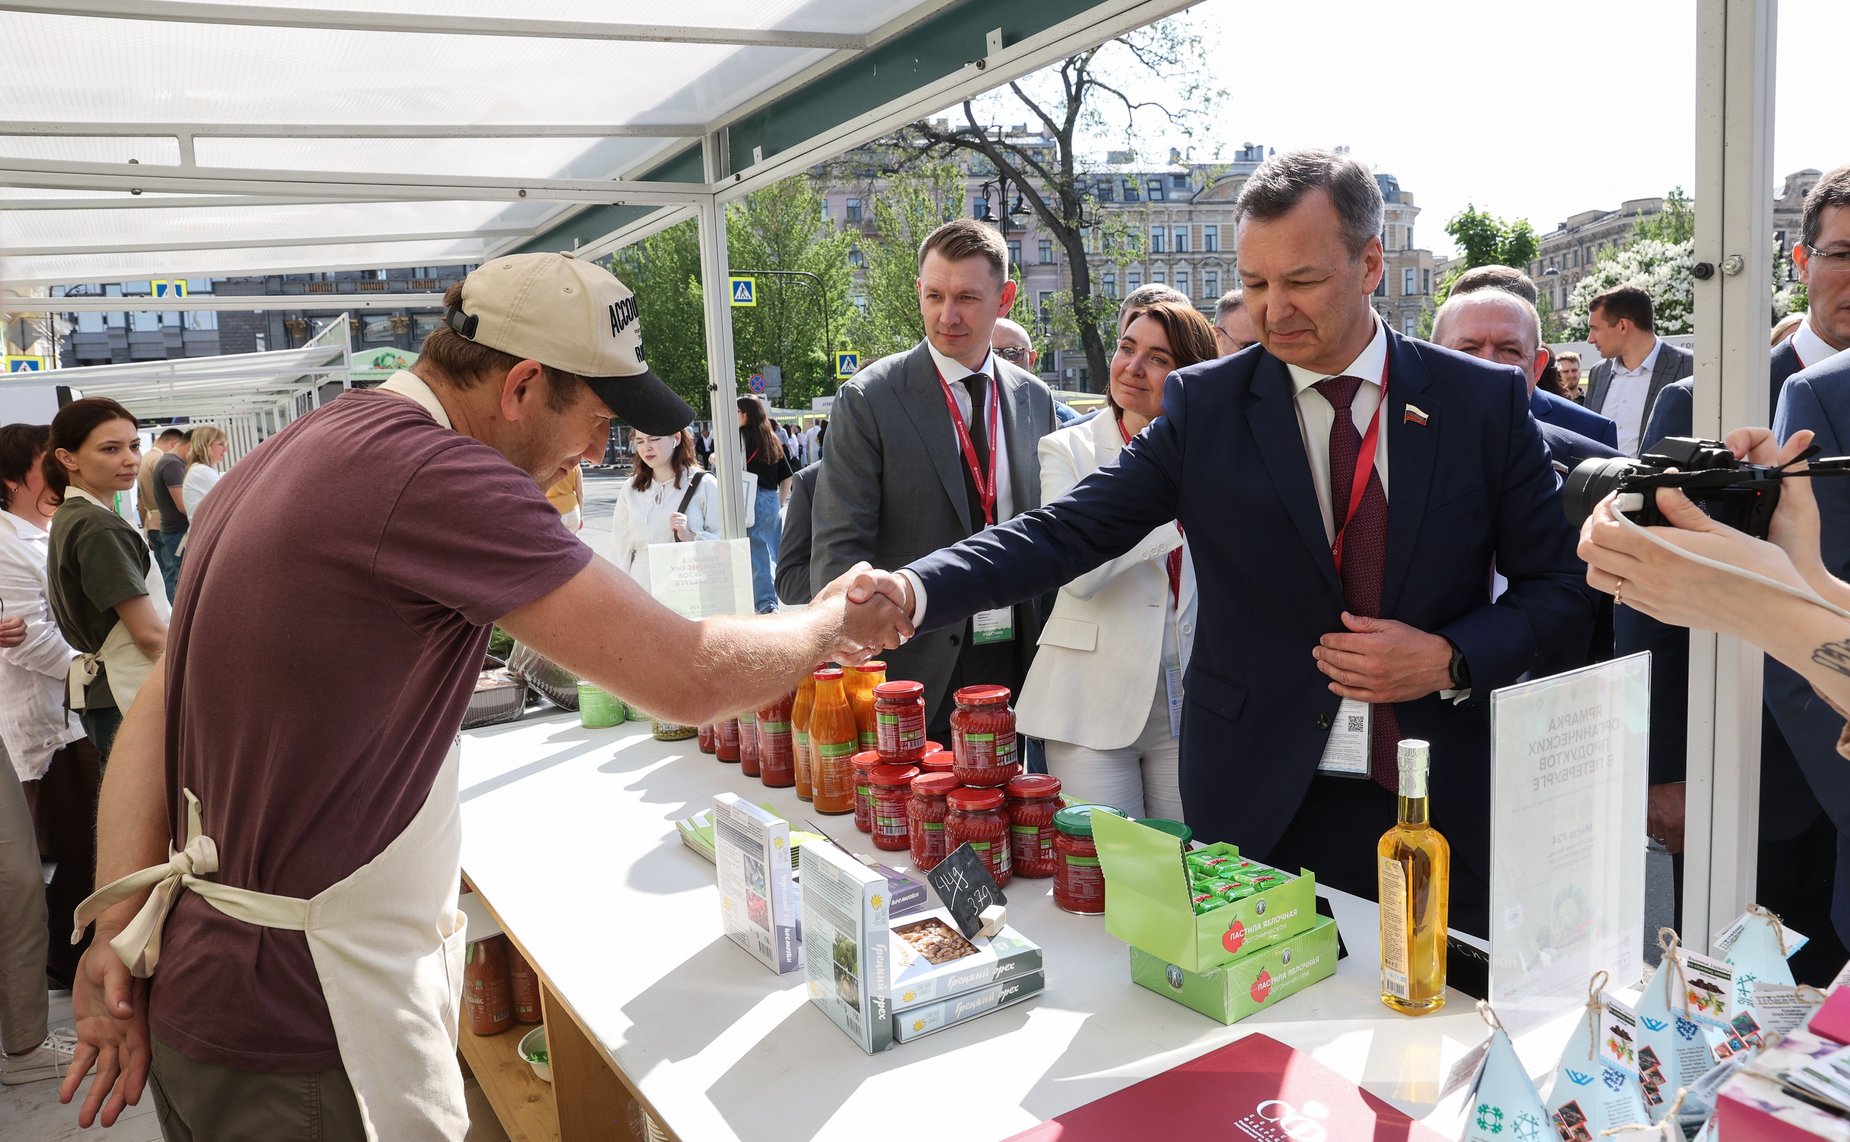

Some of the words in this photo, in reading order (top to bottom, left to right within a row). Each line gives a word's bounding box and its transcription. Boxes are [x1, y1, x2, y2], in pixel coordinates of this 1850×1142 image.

[967, 885, 994, 916] 379
[1229, 922, 1262, 941] ПАСТИЛА
[1262, 909, 1298, 928] ЯБЛОЧНАЯ
[870, 943, 888, 991] Грецкий
[946, 966, 990, 993] Грецкий
[992, 961, 1016, 980] орех
[1257, 972, 1287, 992] ПАСТИЛА
[1287, 956, 1320, 976] ЯБЛОЧНАЯ
[872, 994, 887, 1021] орех
[954, 990, 996, 1019] Грецкий
[998, 983, 1020, 1003] орех
